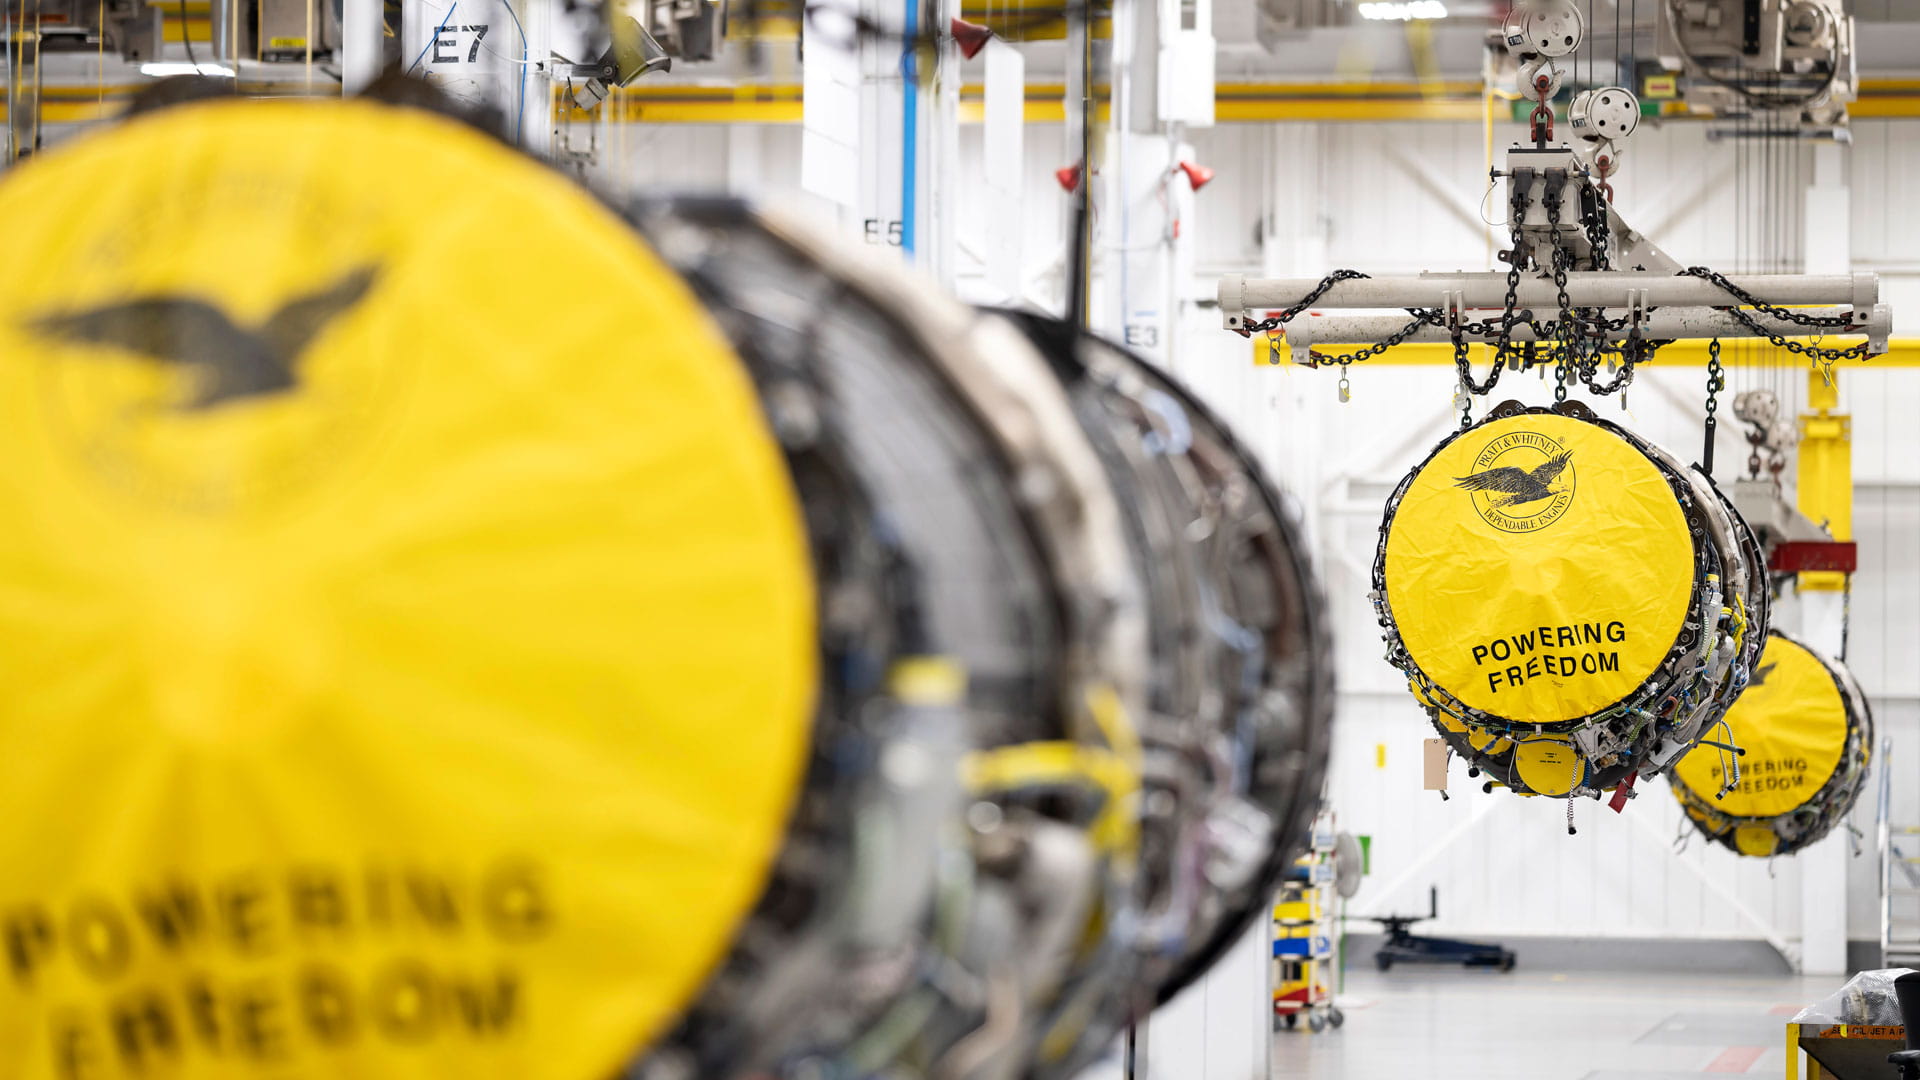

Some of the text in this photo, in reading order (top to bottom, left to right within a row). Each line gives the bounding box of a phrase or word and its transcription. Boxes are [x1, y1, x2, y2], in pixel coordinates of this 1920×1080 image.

[432, 25, 488, 63] E7
[1478, 434, 1559, 467] PRATT & WHITNEY
[1483, 495, 1569, 530] DEPENDABLE ENGINES
[1471, 621, 1625, 666] POWERING
[1488, 651, 1620, 693] FREEDOM
[2, 853, 554, 994] POWERING
